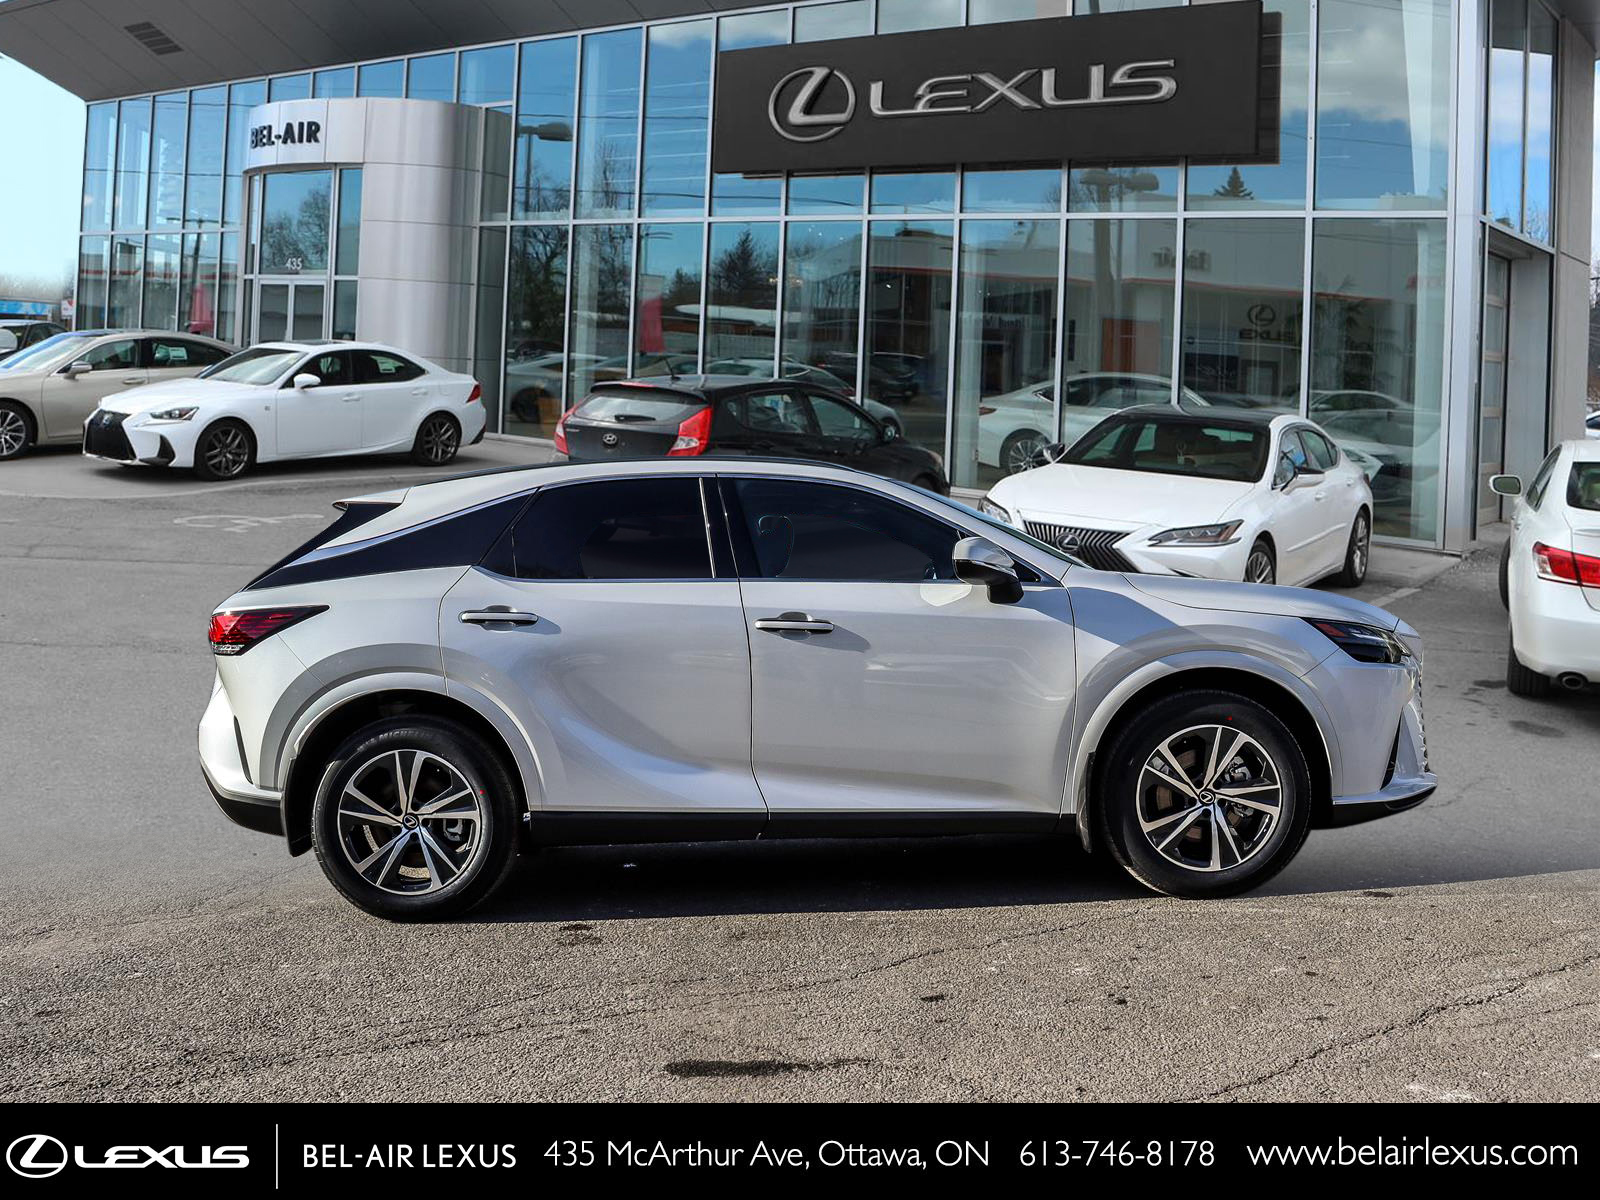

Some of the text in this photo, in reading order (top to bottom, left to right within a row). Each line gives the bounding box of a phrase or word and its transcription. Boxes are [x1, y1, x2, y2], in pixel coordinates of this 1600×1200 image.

[869, 59, 1178, 119] LEXUS
[250, 121, 321, 149] BEL-AIR
[285, 257, 303, 271] 435
